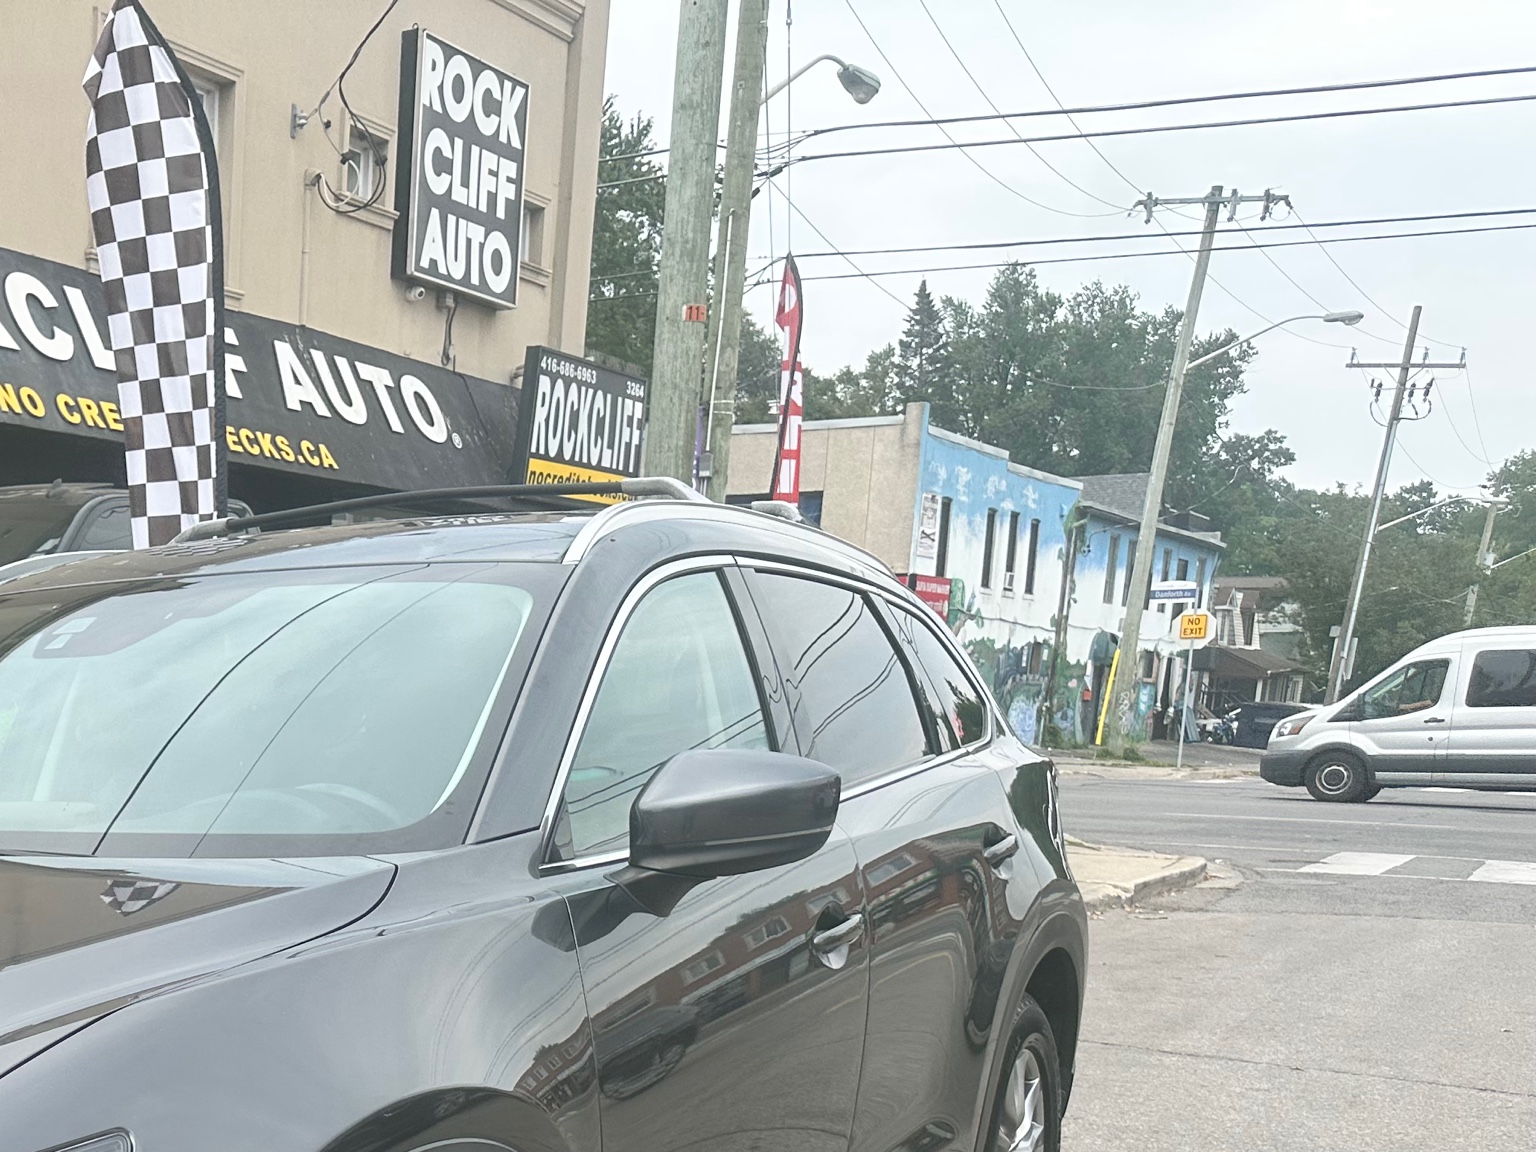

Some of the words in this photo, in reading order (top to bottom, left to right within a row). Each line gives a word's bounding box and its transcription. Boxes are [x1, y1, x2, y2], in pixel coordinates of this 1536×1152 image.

[422, 38, 526, 150] ROCK
[424, 127, 518, 220] CLIFF
[420, 207, 512, 293] AUTO
[540, 356, 597, 384] 416-686-6963
[626, 381, 644, 398] 3264
[57, 393, 124, 432] CRE
[226, 425, 339, 471] ECKS.CA
[530, 375, 643, 473] ROCKCLIFF
[1155, 589, 1183, 598] Danforth
[1183, 627, 1203, 636] EXIT
[1187, 617, 1201, 626] NO
